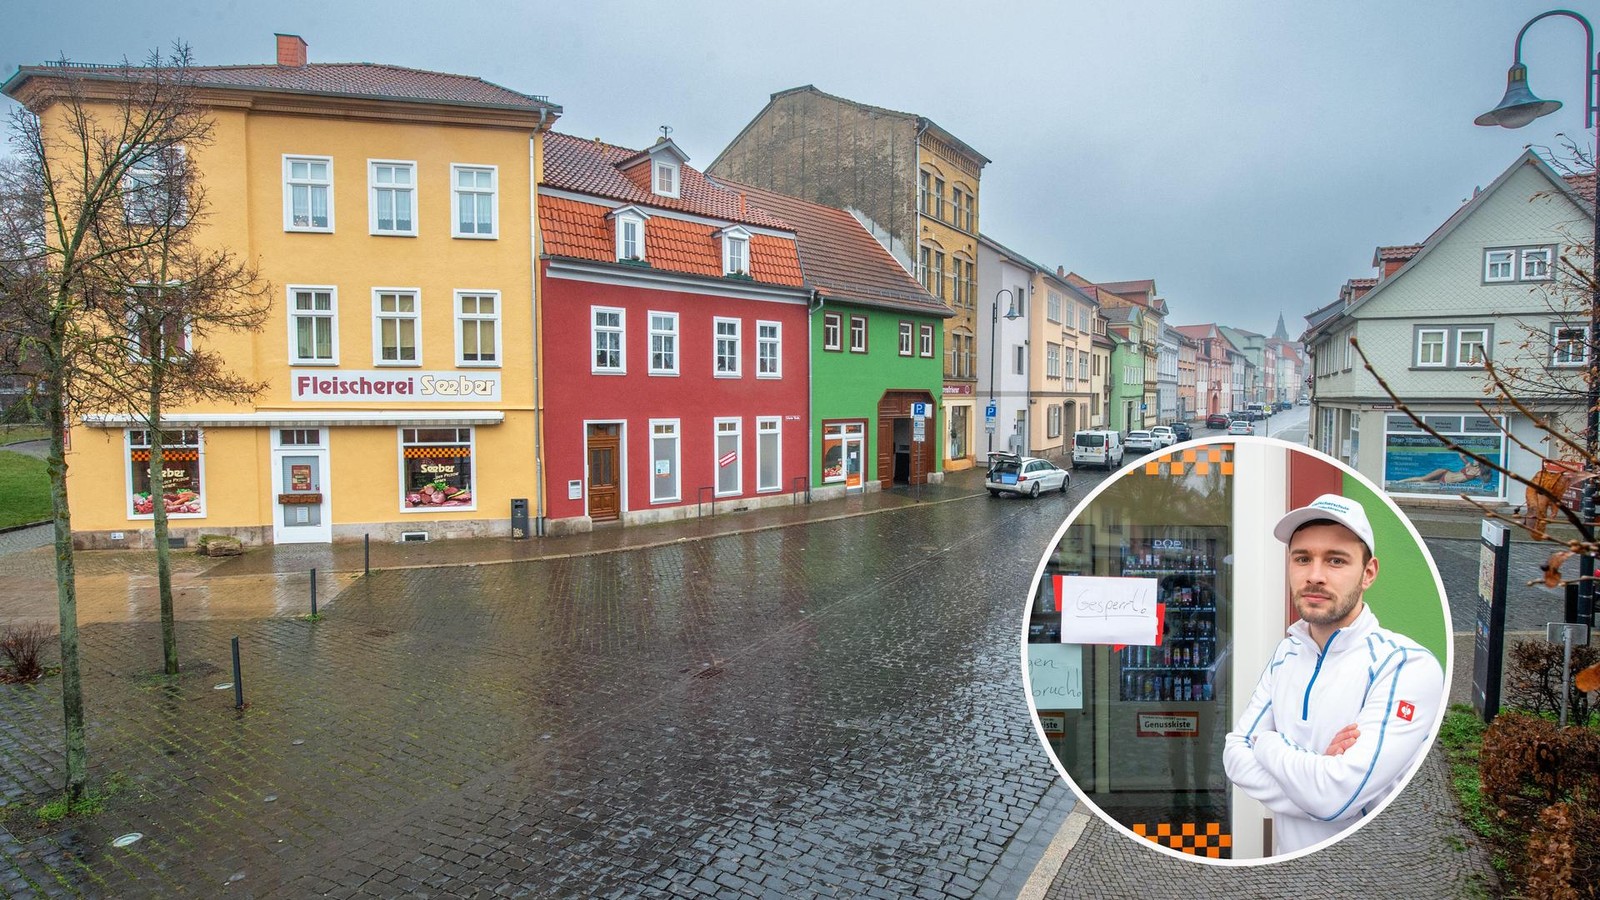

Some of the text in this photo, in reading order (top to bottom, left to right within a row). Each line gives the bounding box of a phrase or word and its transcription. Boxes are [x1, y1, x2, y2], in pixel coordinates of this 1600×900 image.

[298, 375, 495, 396] Fleischerei Seeber
[420, 464, 456, 474] Seeber
[1075, 589, 1148, 620] Gesperrt!
[1031, 667, 1081, 697] bruch!
[1144, 720, 1191, 729] Genusskiste
